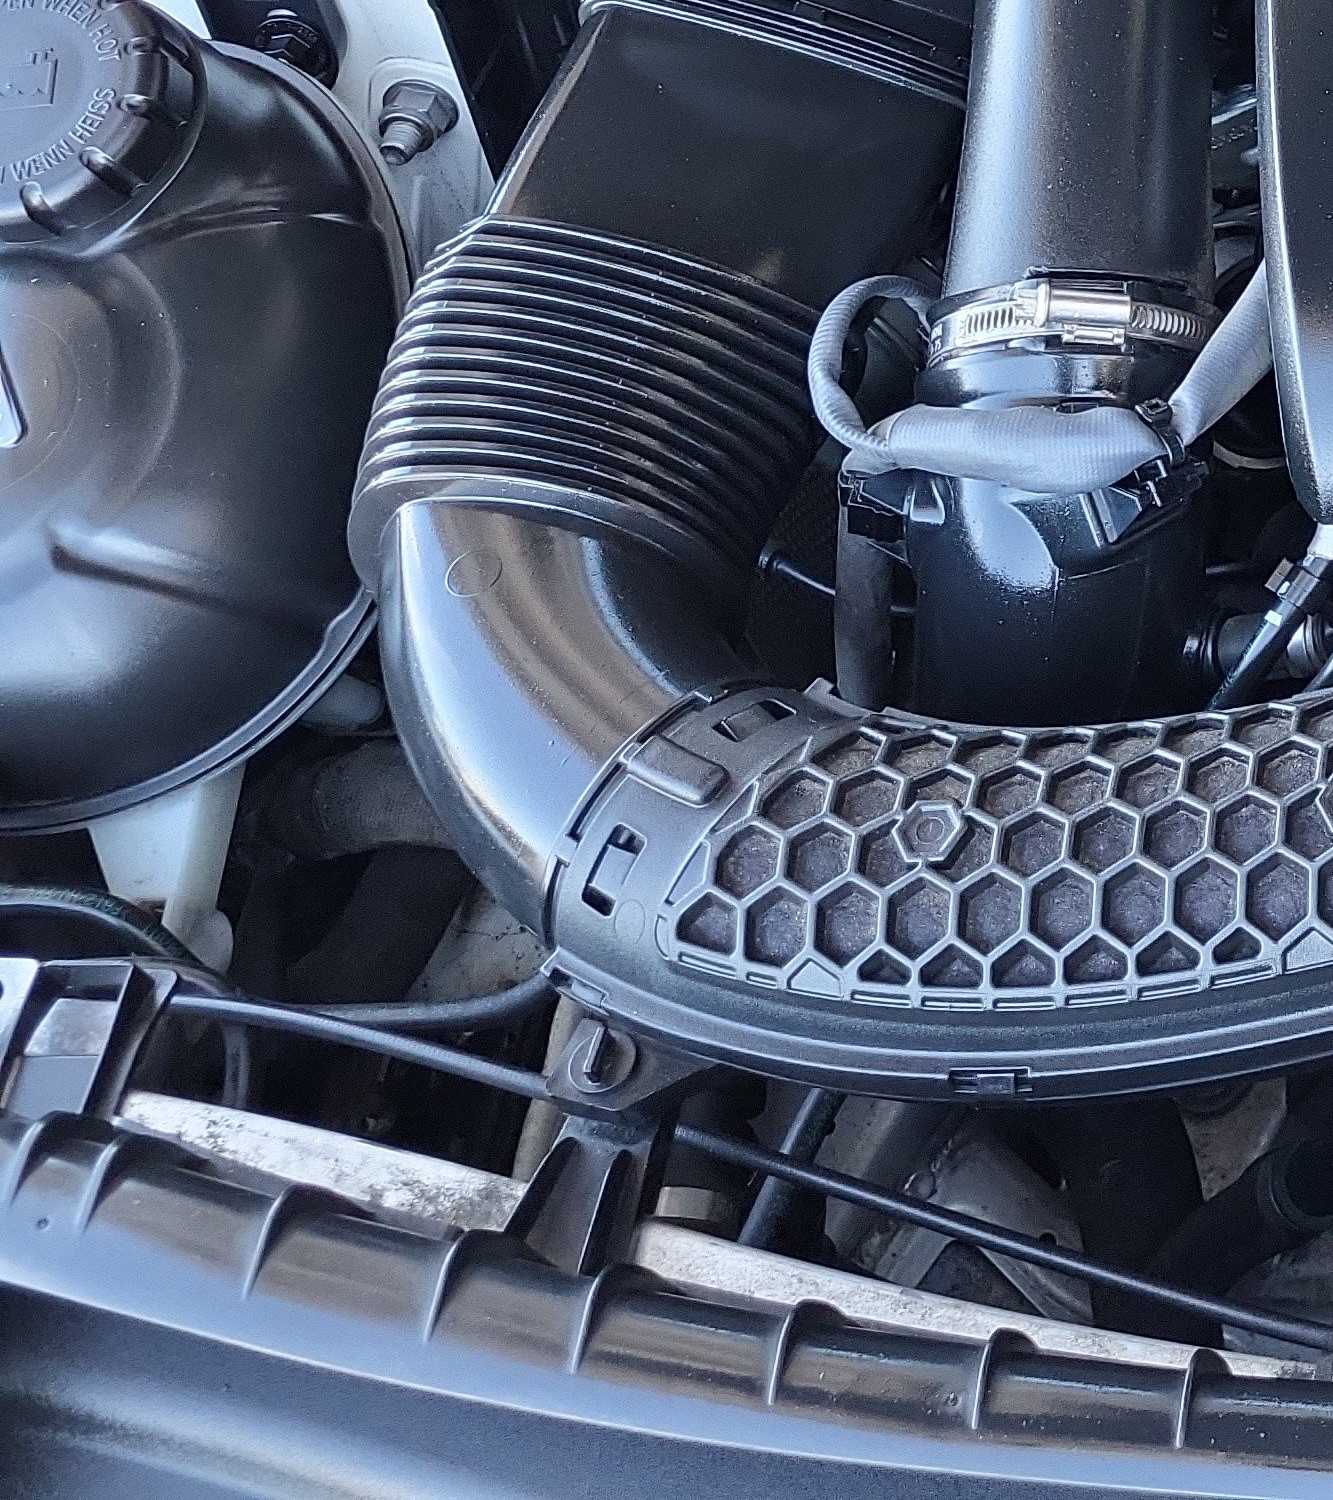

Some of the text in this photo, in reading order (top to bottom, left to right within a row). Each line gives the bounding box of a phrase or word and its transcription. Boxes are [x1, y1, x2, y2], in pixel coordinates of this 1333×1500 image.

[89, 23, 122, 61] HOT
[10, 88, 116, 182] WENN HEISS
